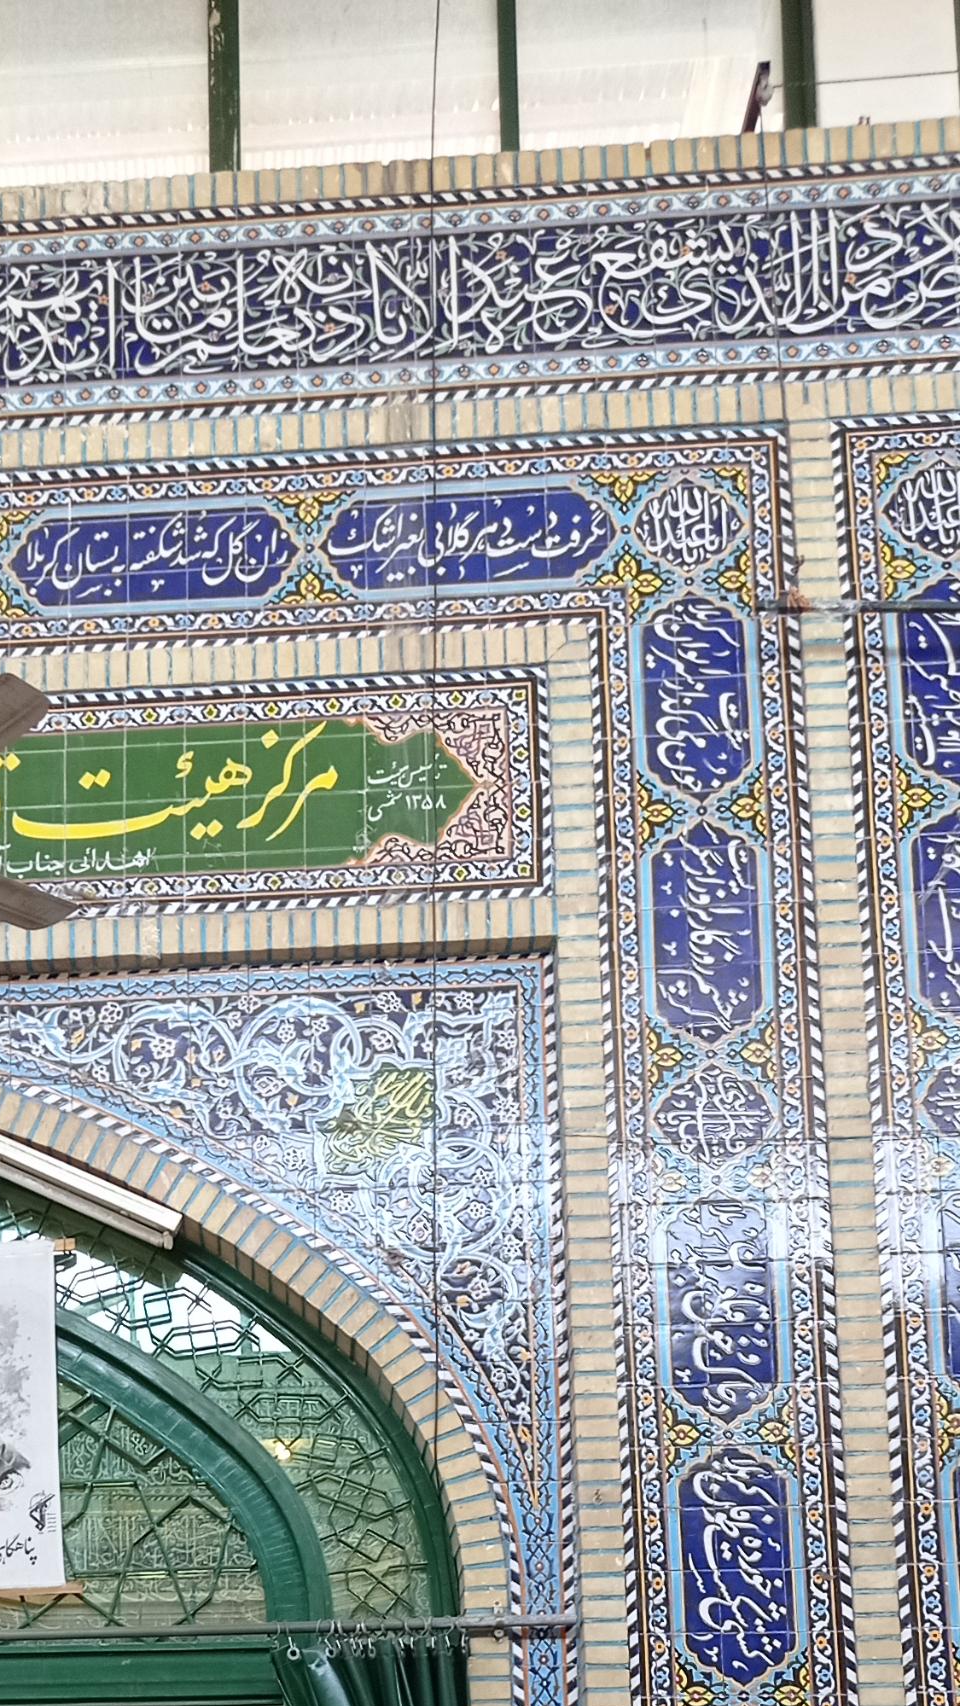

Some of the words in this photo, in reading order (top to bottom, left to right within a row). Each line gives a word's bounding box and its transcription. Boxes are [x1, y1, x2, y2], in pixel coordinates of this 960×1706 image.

[27, 528, 79, 595] کربلا
[676, 602, 739, 647] کربلا
[12, 750, 253, 840] هیئت
[237, 720, 338, 841] مرکز
[7, 851, 64, 879] جناب
[713, 1457, 778, 1506] کربلا
